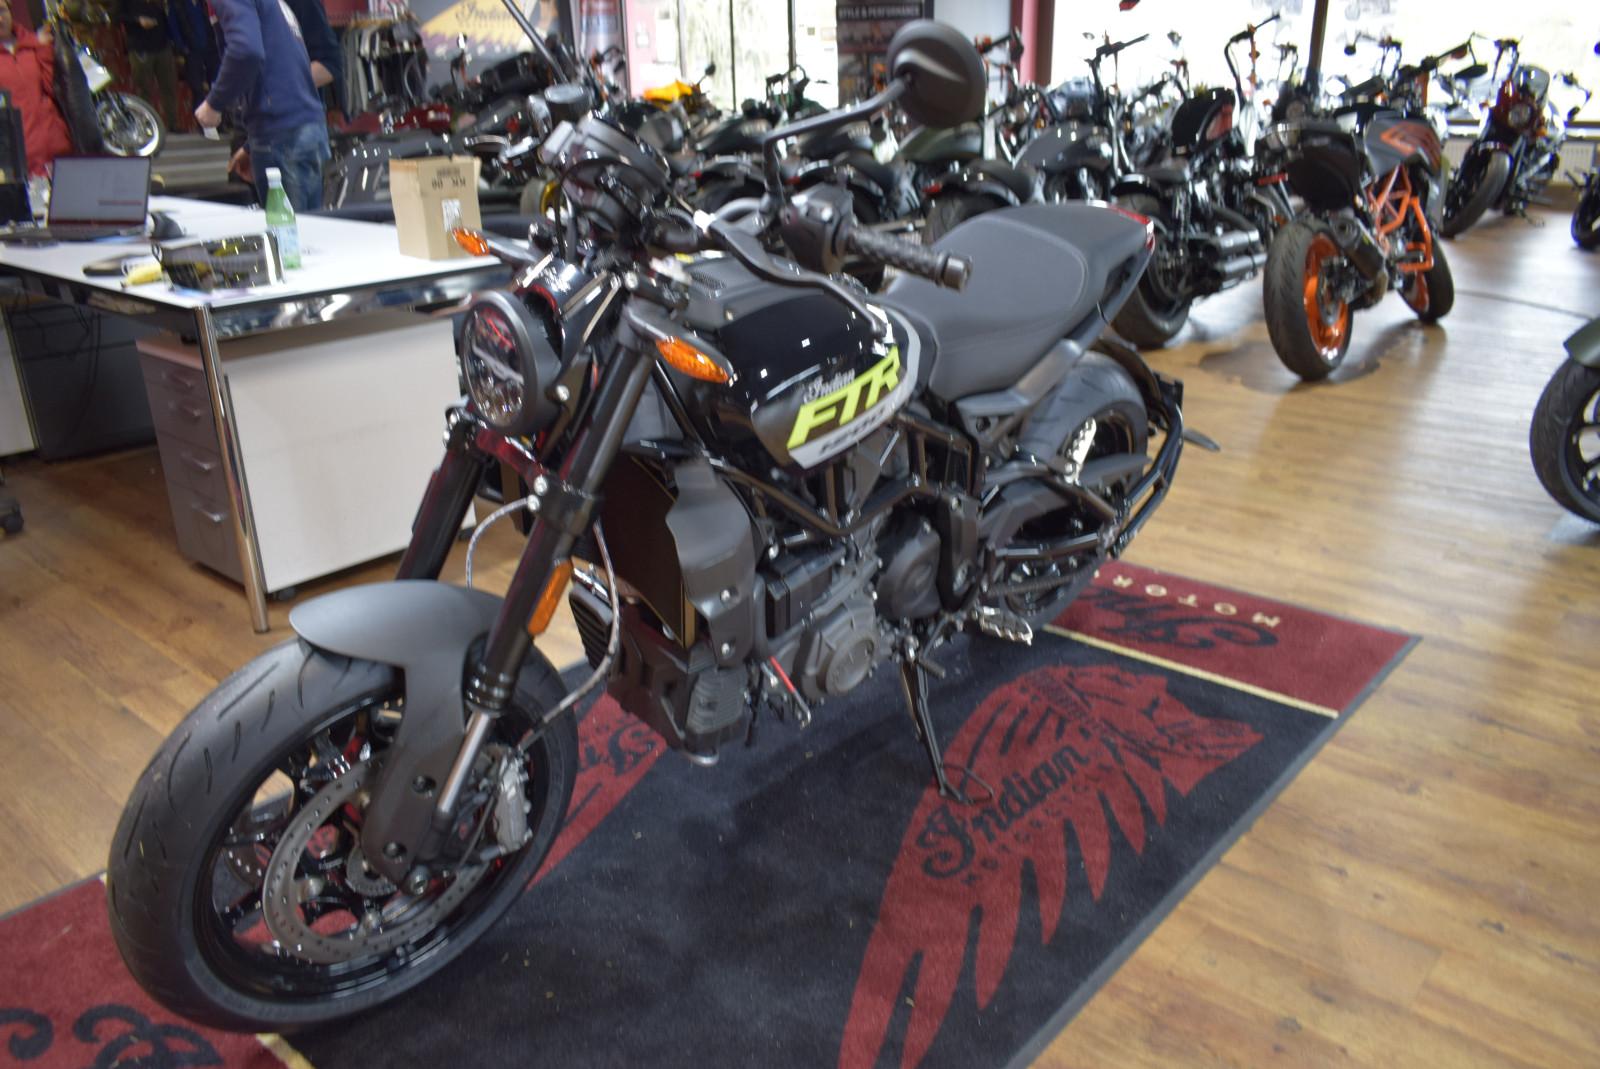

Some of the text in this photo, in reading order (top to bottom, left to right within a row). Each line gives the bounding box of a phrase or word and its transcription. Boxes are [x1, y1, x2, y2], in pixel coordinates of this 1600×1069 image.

[838, 7, 860, 18] STYLE
[786, 345, 900, 450] FTR
[916, 745, 1090, 879] Indian
